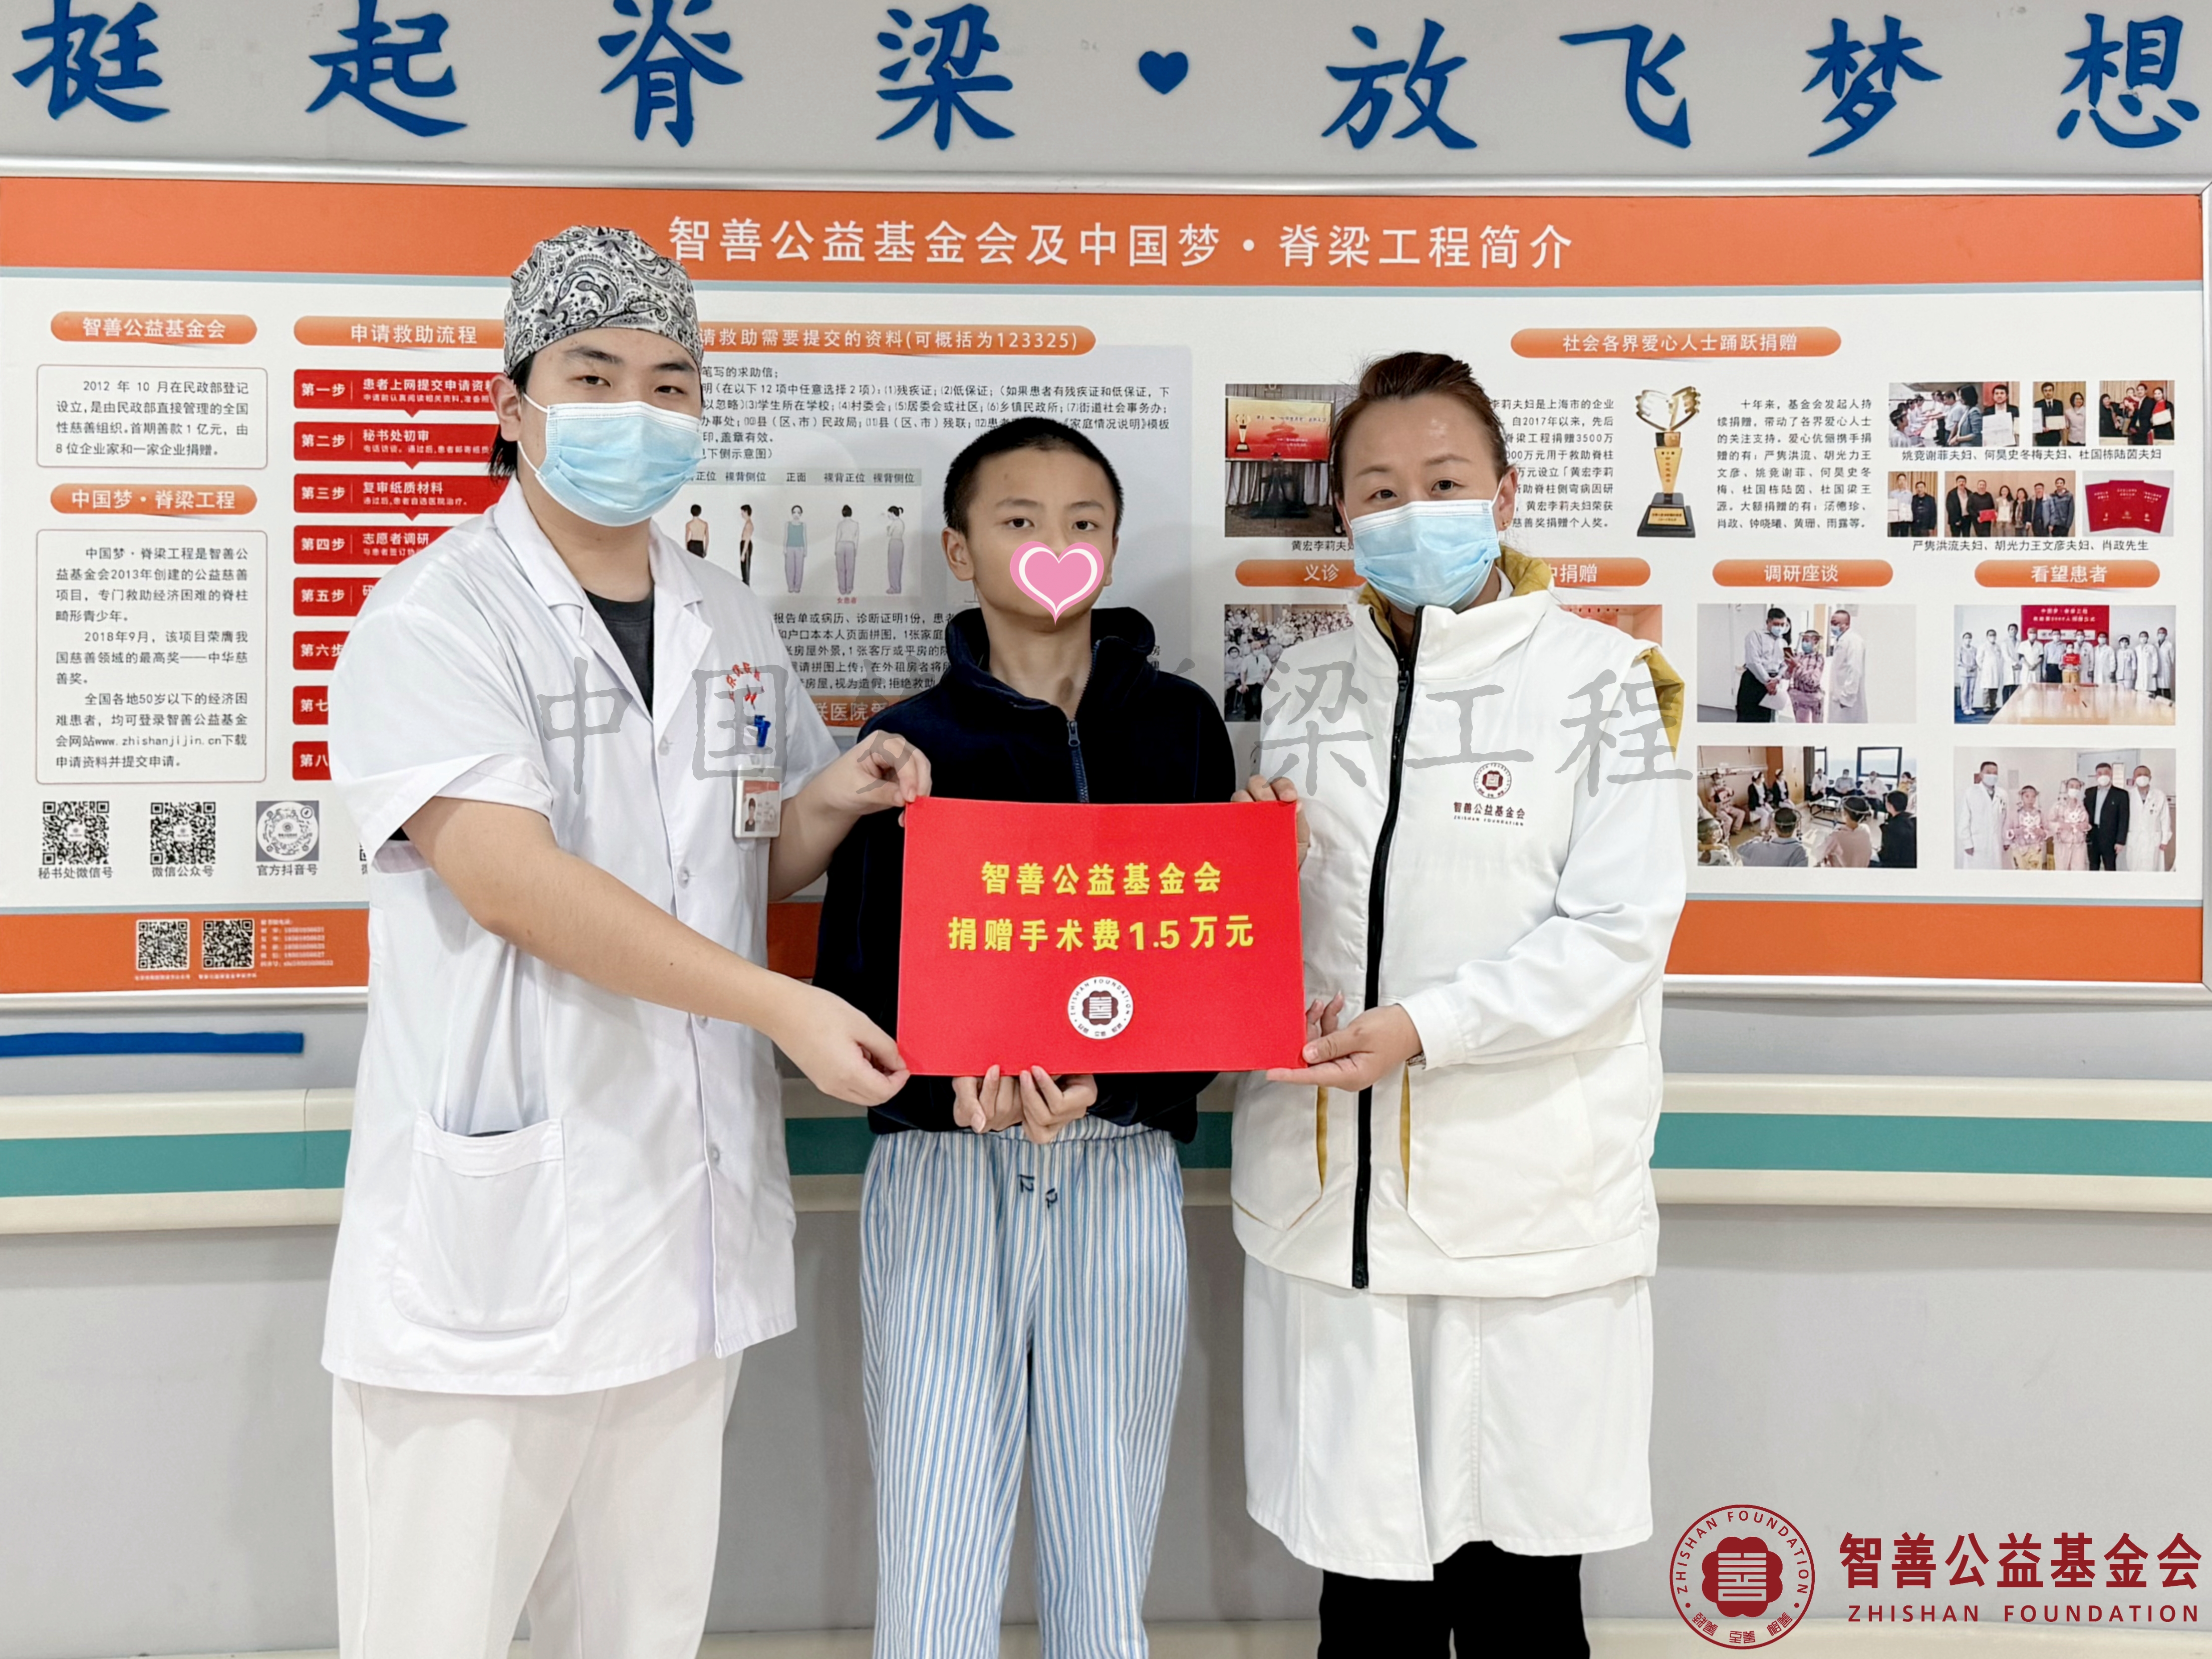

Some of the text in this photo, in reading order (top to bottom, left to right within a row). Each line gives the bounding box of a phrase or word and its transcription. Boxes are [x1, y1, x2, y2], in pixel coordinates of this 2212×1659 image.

[12, 0, 2201, 157] 挺起脊梁 放飞梦想
[668, 215, 1573, 270] 智善公益基金会及中国梦·脊梁工程简介
[83, 317, 226, 339] 智善公益基金会
[350, 324, 478, 345] 申请救助流程
[1563, 334, 1797, 352] 社会各界爱心人士踊跃捐赠
[84, 381, 249, 395] 2012 年 10 月在民政部登记
[301, 382, 346, 397] 第一步
[1741, 399, 1871, 410] 十年来，基金会发起人持
[1717, 416, 1871, 427] 续捐赠，带动了各界爱心人士
[301, 434, 346, 448] 第二步
[363, 429, 429, 442] 秘书处初审
[786, 472, 806, 482] 正面
[301, 486, 346, 500] 第三步
[363, 481, 443, 494] 复审纸质材料
[72, 488, 235, 510] 中国梦·脊梁工程
[301, 537, 345, 550] 第四步
[363, 532, 429, 545] 志愿者调研
[86, 547, 248, 561] 中国梦·脊梁工程是智善公
[56, 568, 248, 581] 益基金会2013年创建的公益慈善
[1304, 564, 1339, 582] 义诊
[1764, 564, 1838, 583] 调研座谈
[2031, 565, 2107, 584] 看望患者
[56, 589, 248, 602] 项目，专门救助经济困难的脊柱
[301, 589, 345, 603] 第五步
[56, 610, 129, 622] 畸形青少年。
[301, 644, 343, 657] 第六步
[56, 672, 89, 685] 善奖。
[85, 692, 248, 705] 全国各地50岁以下的经济困
[56, 713, 248, 727] 难患者，均可登录智善公益基金
[56, 755, 180, 768] 申请资料并提交申请。
[1454, 802, 1525, 819] 智善公益基金会
[38, 867, 113, 879] 秘书处微信号
[152, 866, 214, 878] 微信公众号
[257, 864, 318, 876] 官方抖音号
[981, 861, 1221, 895] 智善公益基金会
[949, 915, 1254, 951] 捐赠手术费1.5万元
